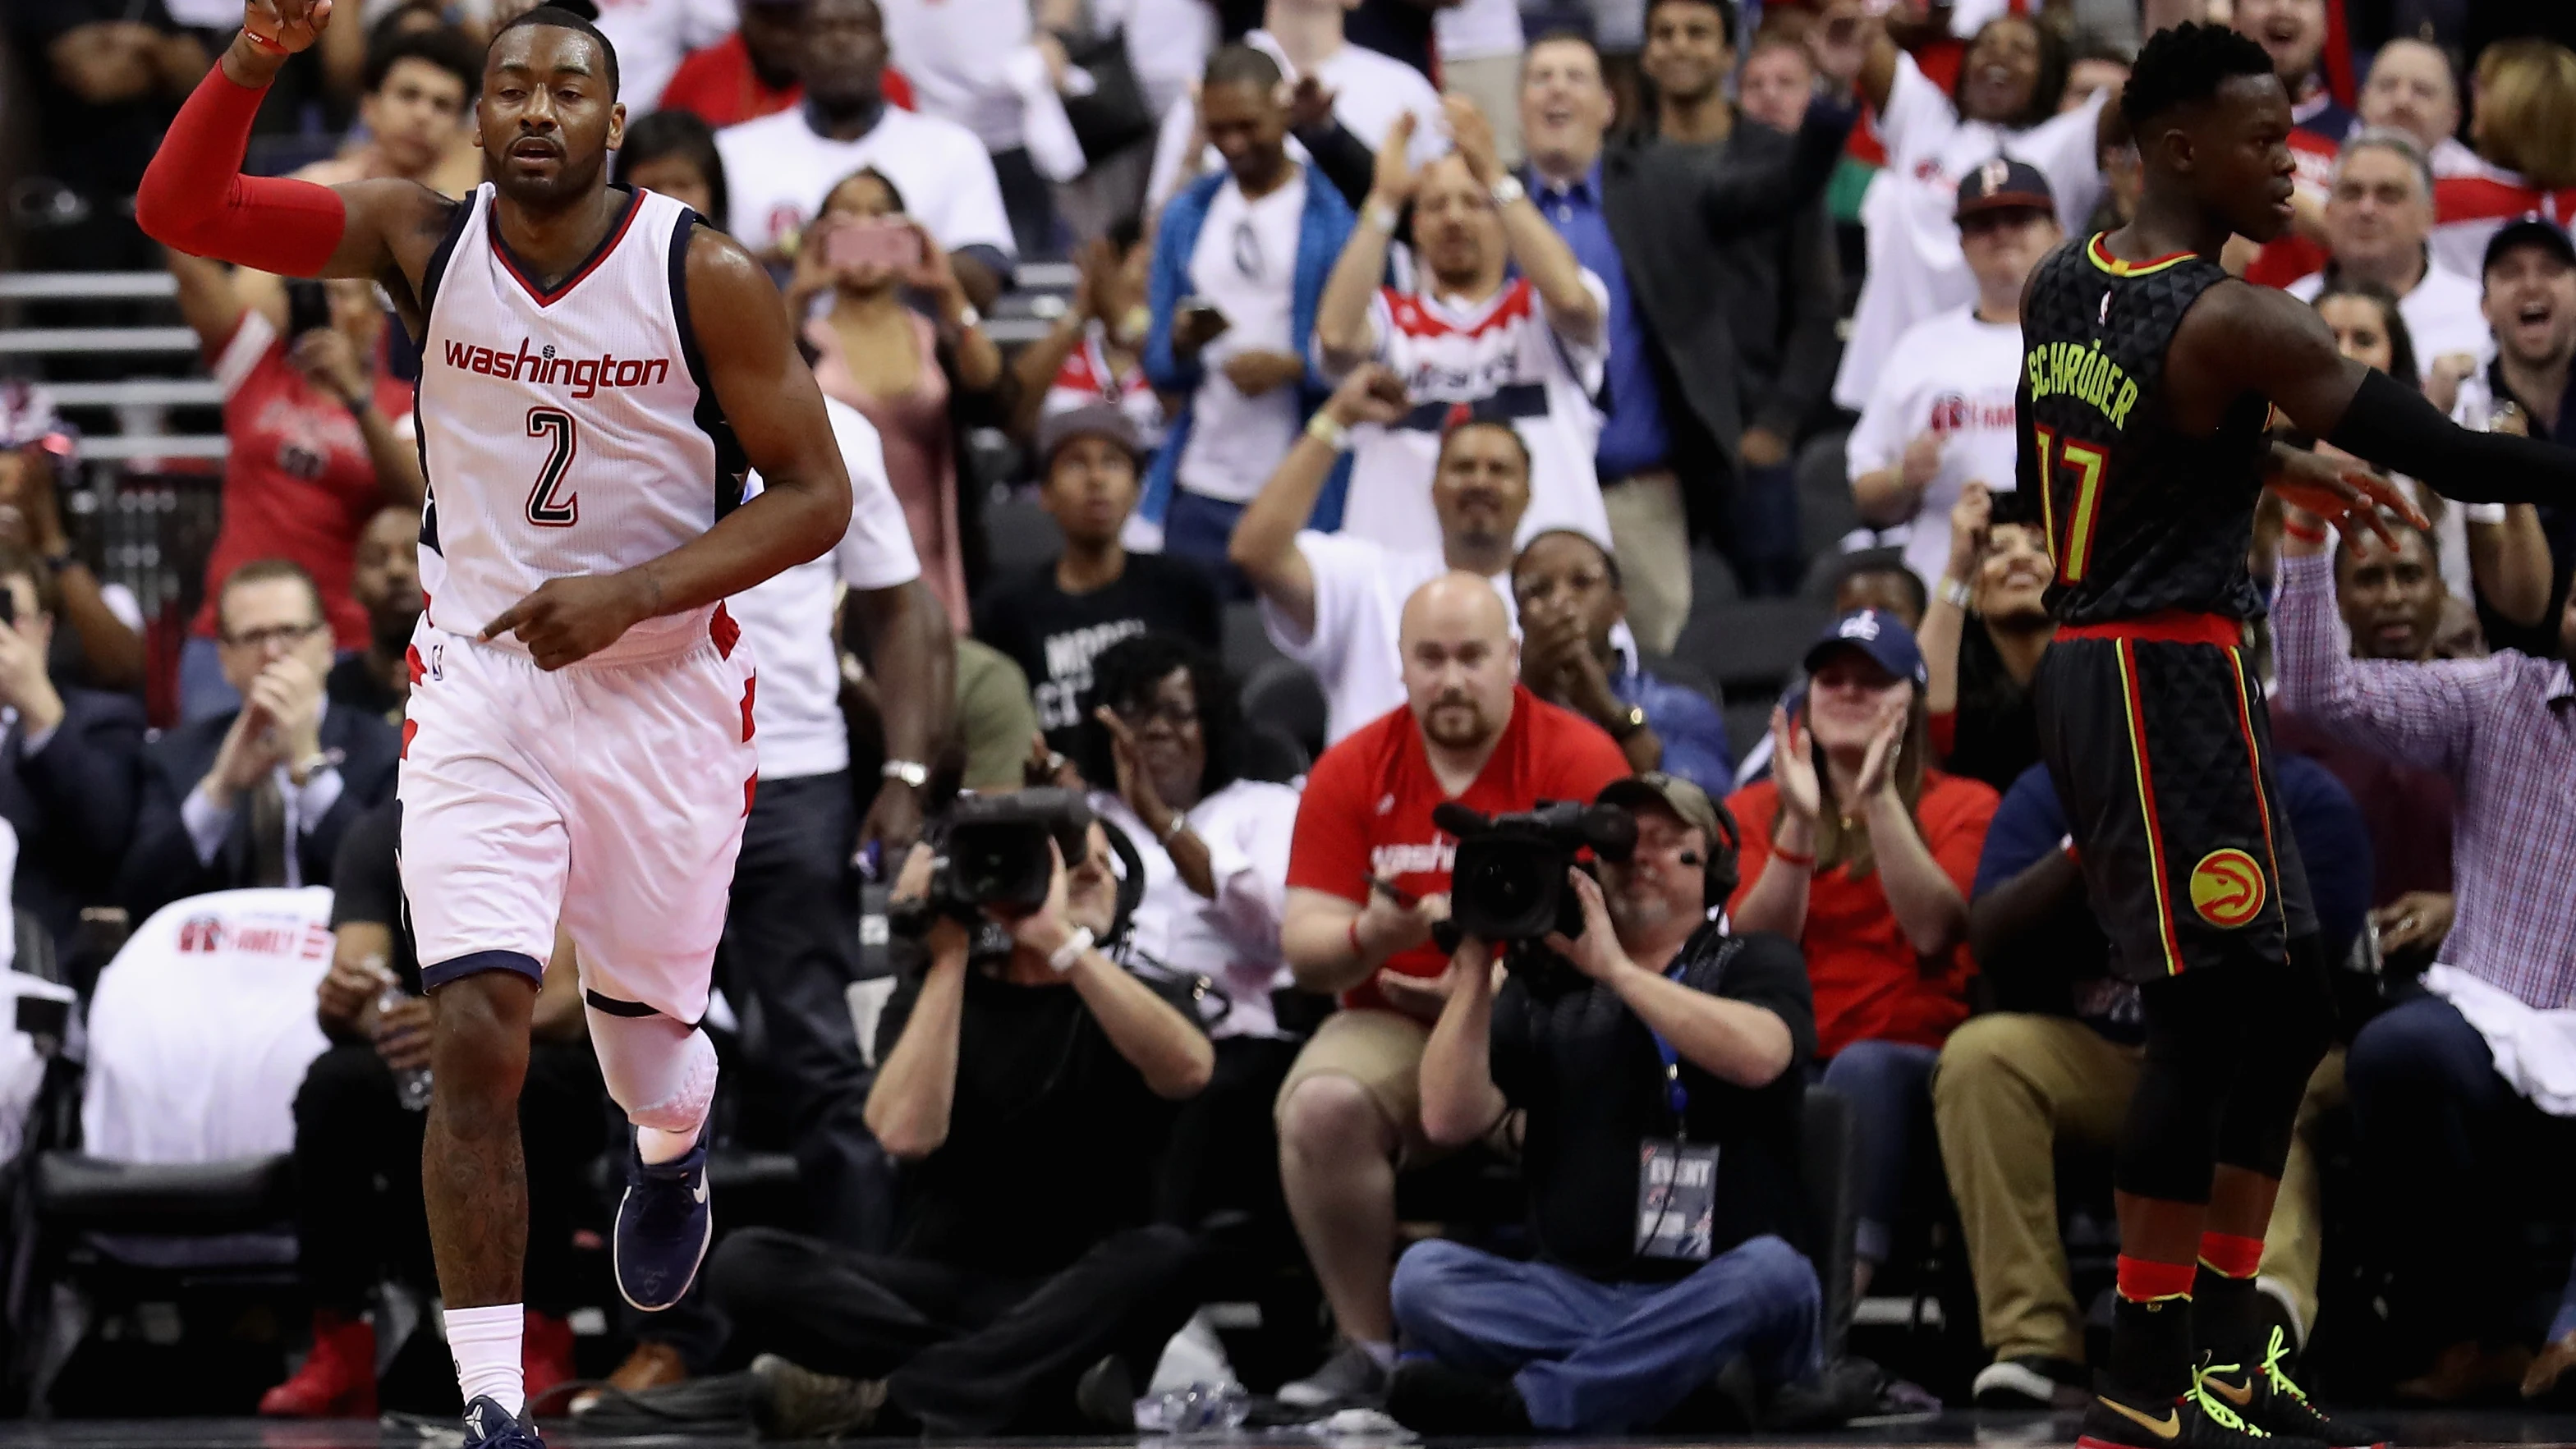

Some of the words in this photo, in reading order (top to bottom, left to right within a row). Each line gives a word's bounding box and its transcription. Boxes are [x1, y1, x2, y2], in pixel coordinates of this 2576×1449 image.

[444, 337, 669, 399] washington
[526, 406, 578, 526] 2
[2035, 422, 2110, 586] 17
